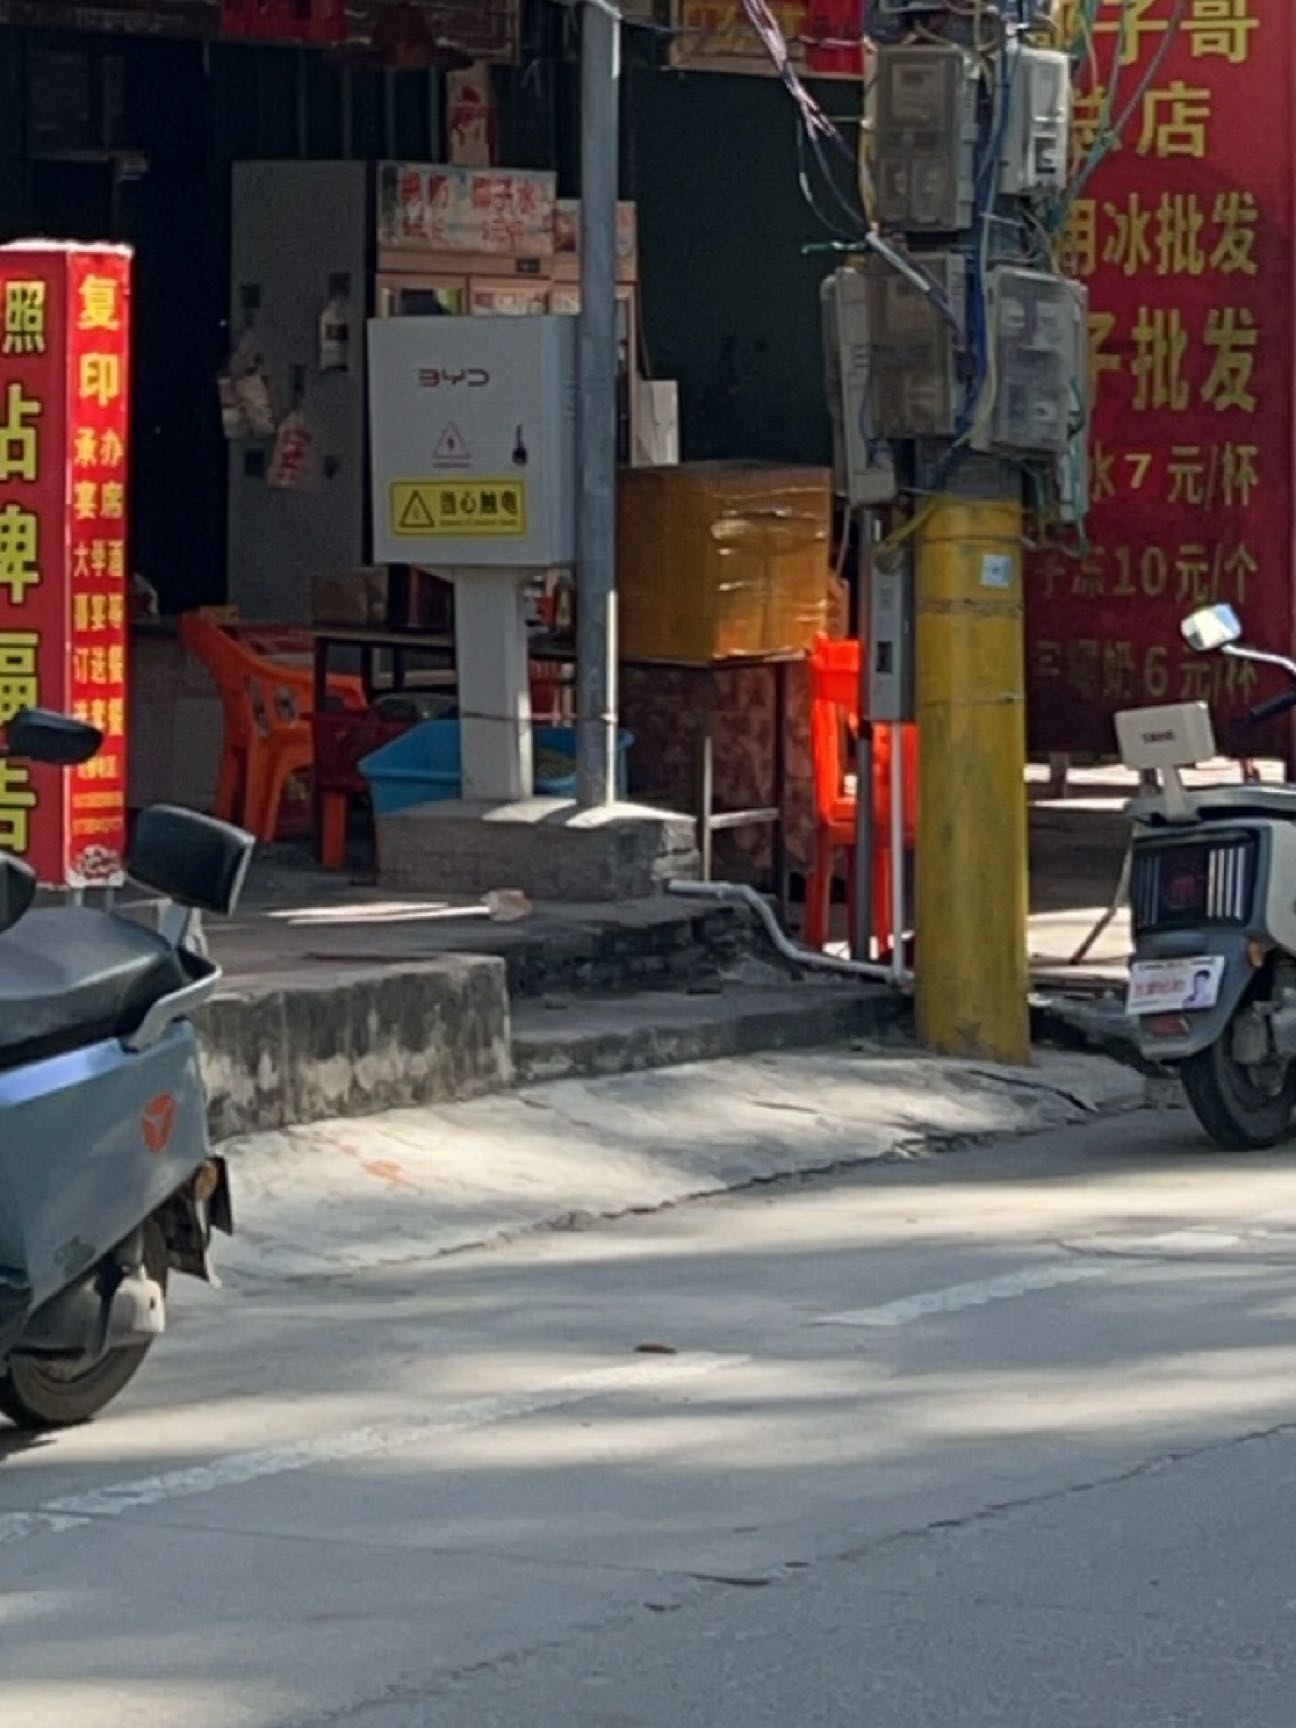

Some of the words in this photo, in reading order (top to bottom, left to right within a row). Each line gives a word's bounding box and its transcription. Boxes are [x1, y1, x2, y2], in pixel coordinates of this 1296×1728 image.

[77, 272, 121, 408] 复印
[418, 368, 490, 388] BYD
[440, 490, 519, 516] 当心触电
